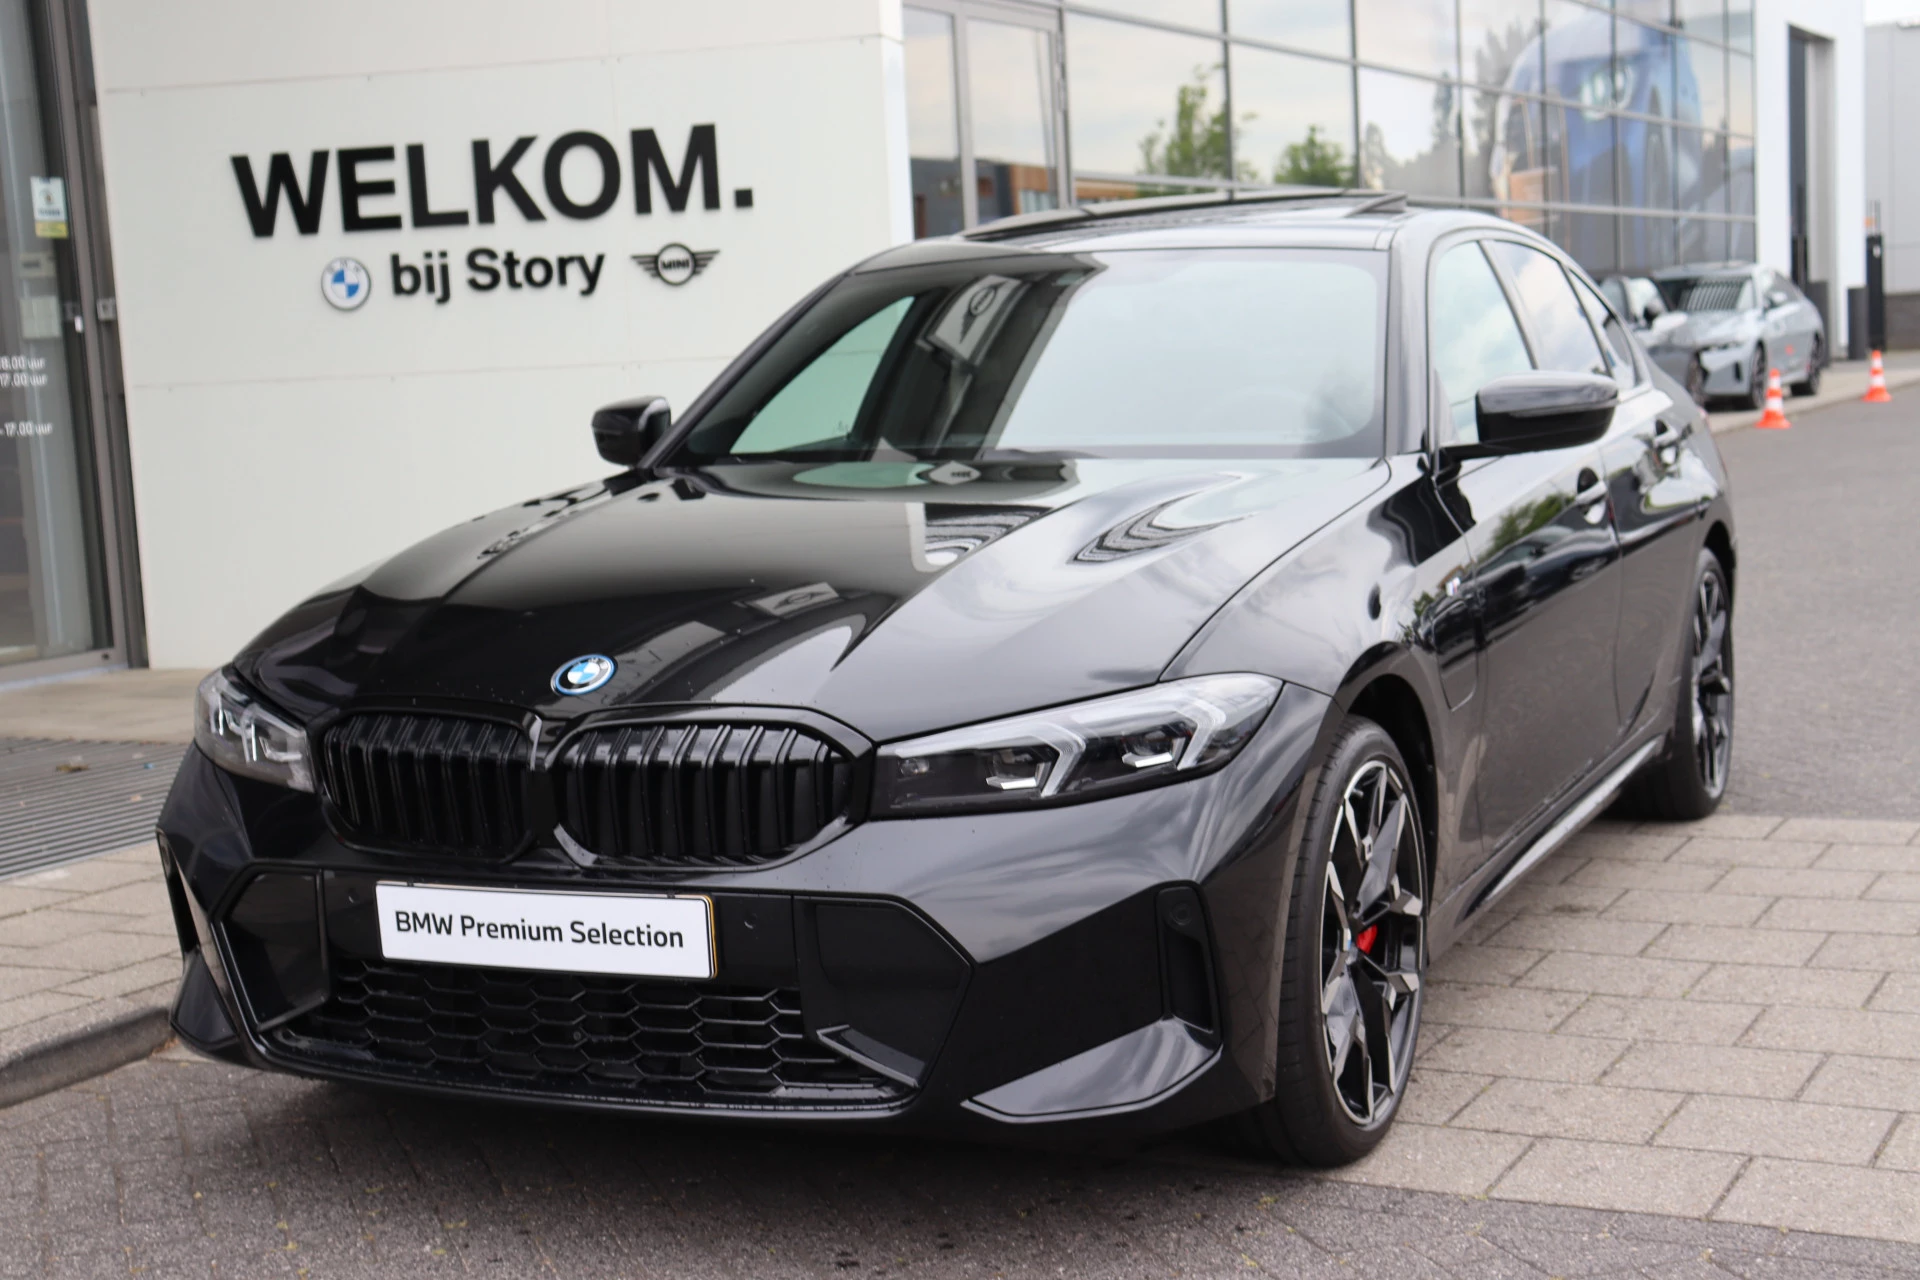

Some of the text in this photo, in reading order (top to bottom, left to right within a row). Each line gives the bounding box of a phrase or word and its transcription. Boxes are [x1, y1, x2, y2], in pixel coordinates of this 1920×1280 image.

[230, 123, 755, 239] WELKOM.
[390, 247, 606, 305] bij Story
[661, 259, 690, 269] MINI
[0, 355, 26, 370] 8.00
[394, 910, 685, 949] BMW Premium Selection
